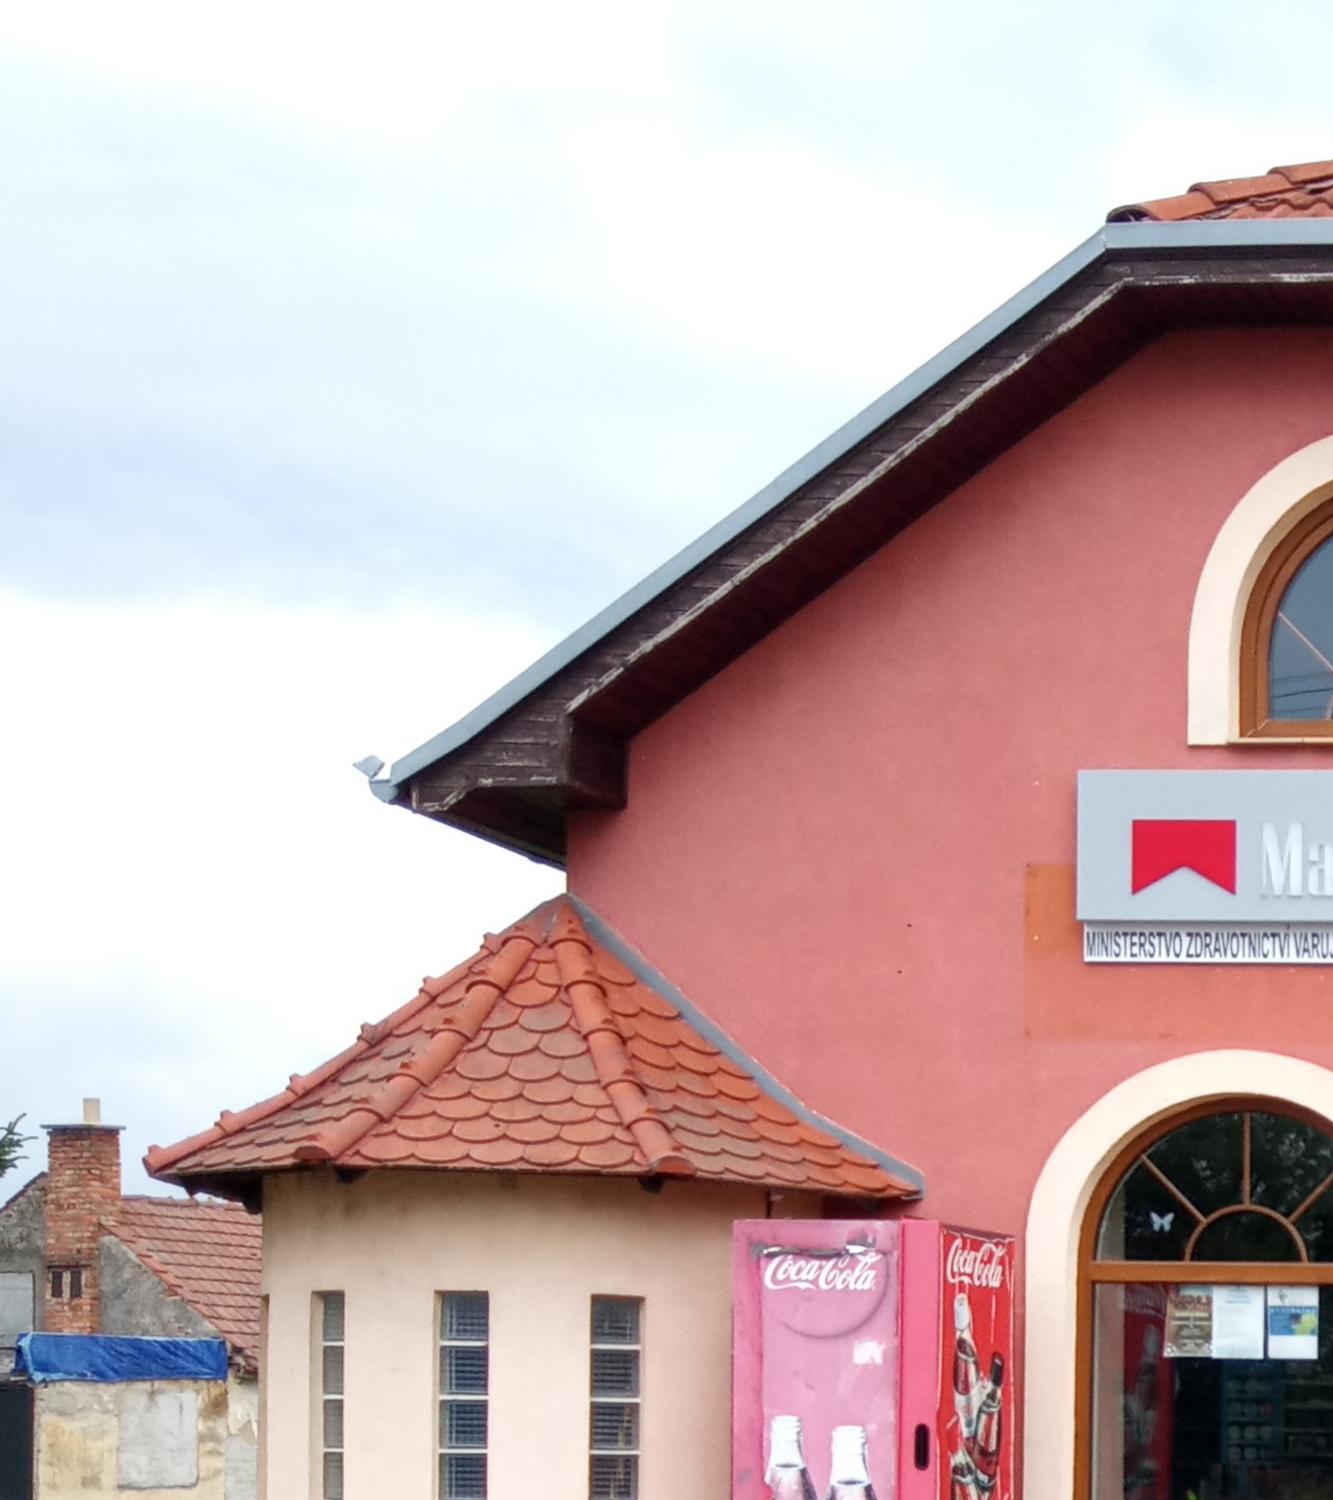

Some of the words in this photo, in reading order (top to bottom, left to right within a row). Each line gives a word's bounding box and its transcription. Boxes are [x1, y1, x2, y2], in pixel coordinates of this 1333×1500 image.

[1085, 930, 1183, 959] MINISTERSTVO
[1185, 923, 1291, 960] ZDRAVOTNICTVÍ
[764, 1251, 883, 1291] Coca-Cola
[946, 1238, 1007, 1289] Coca-Cola
